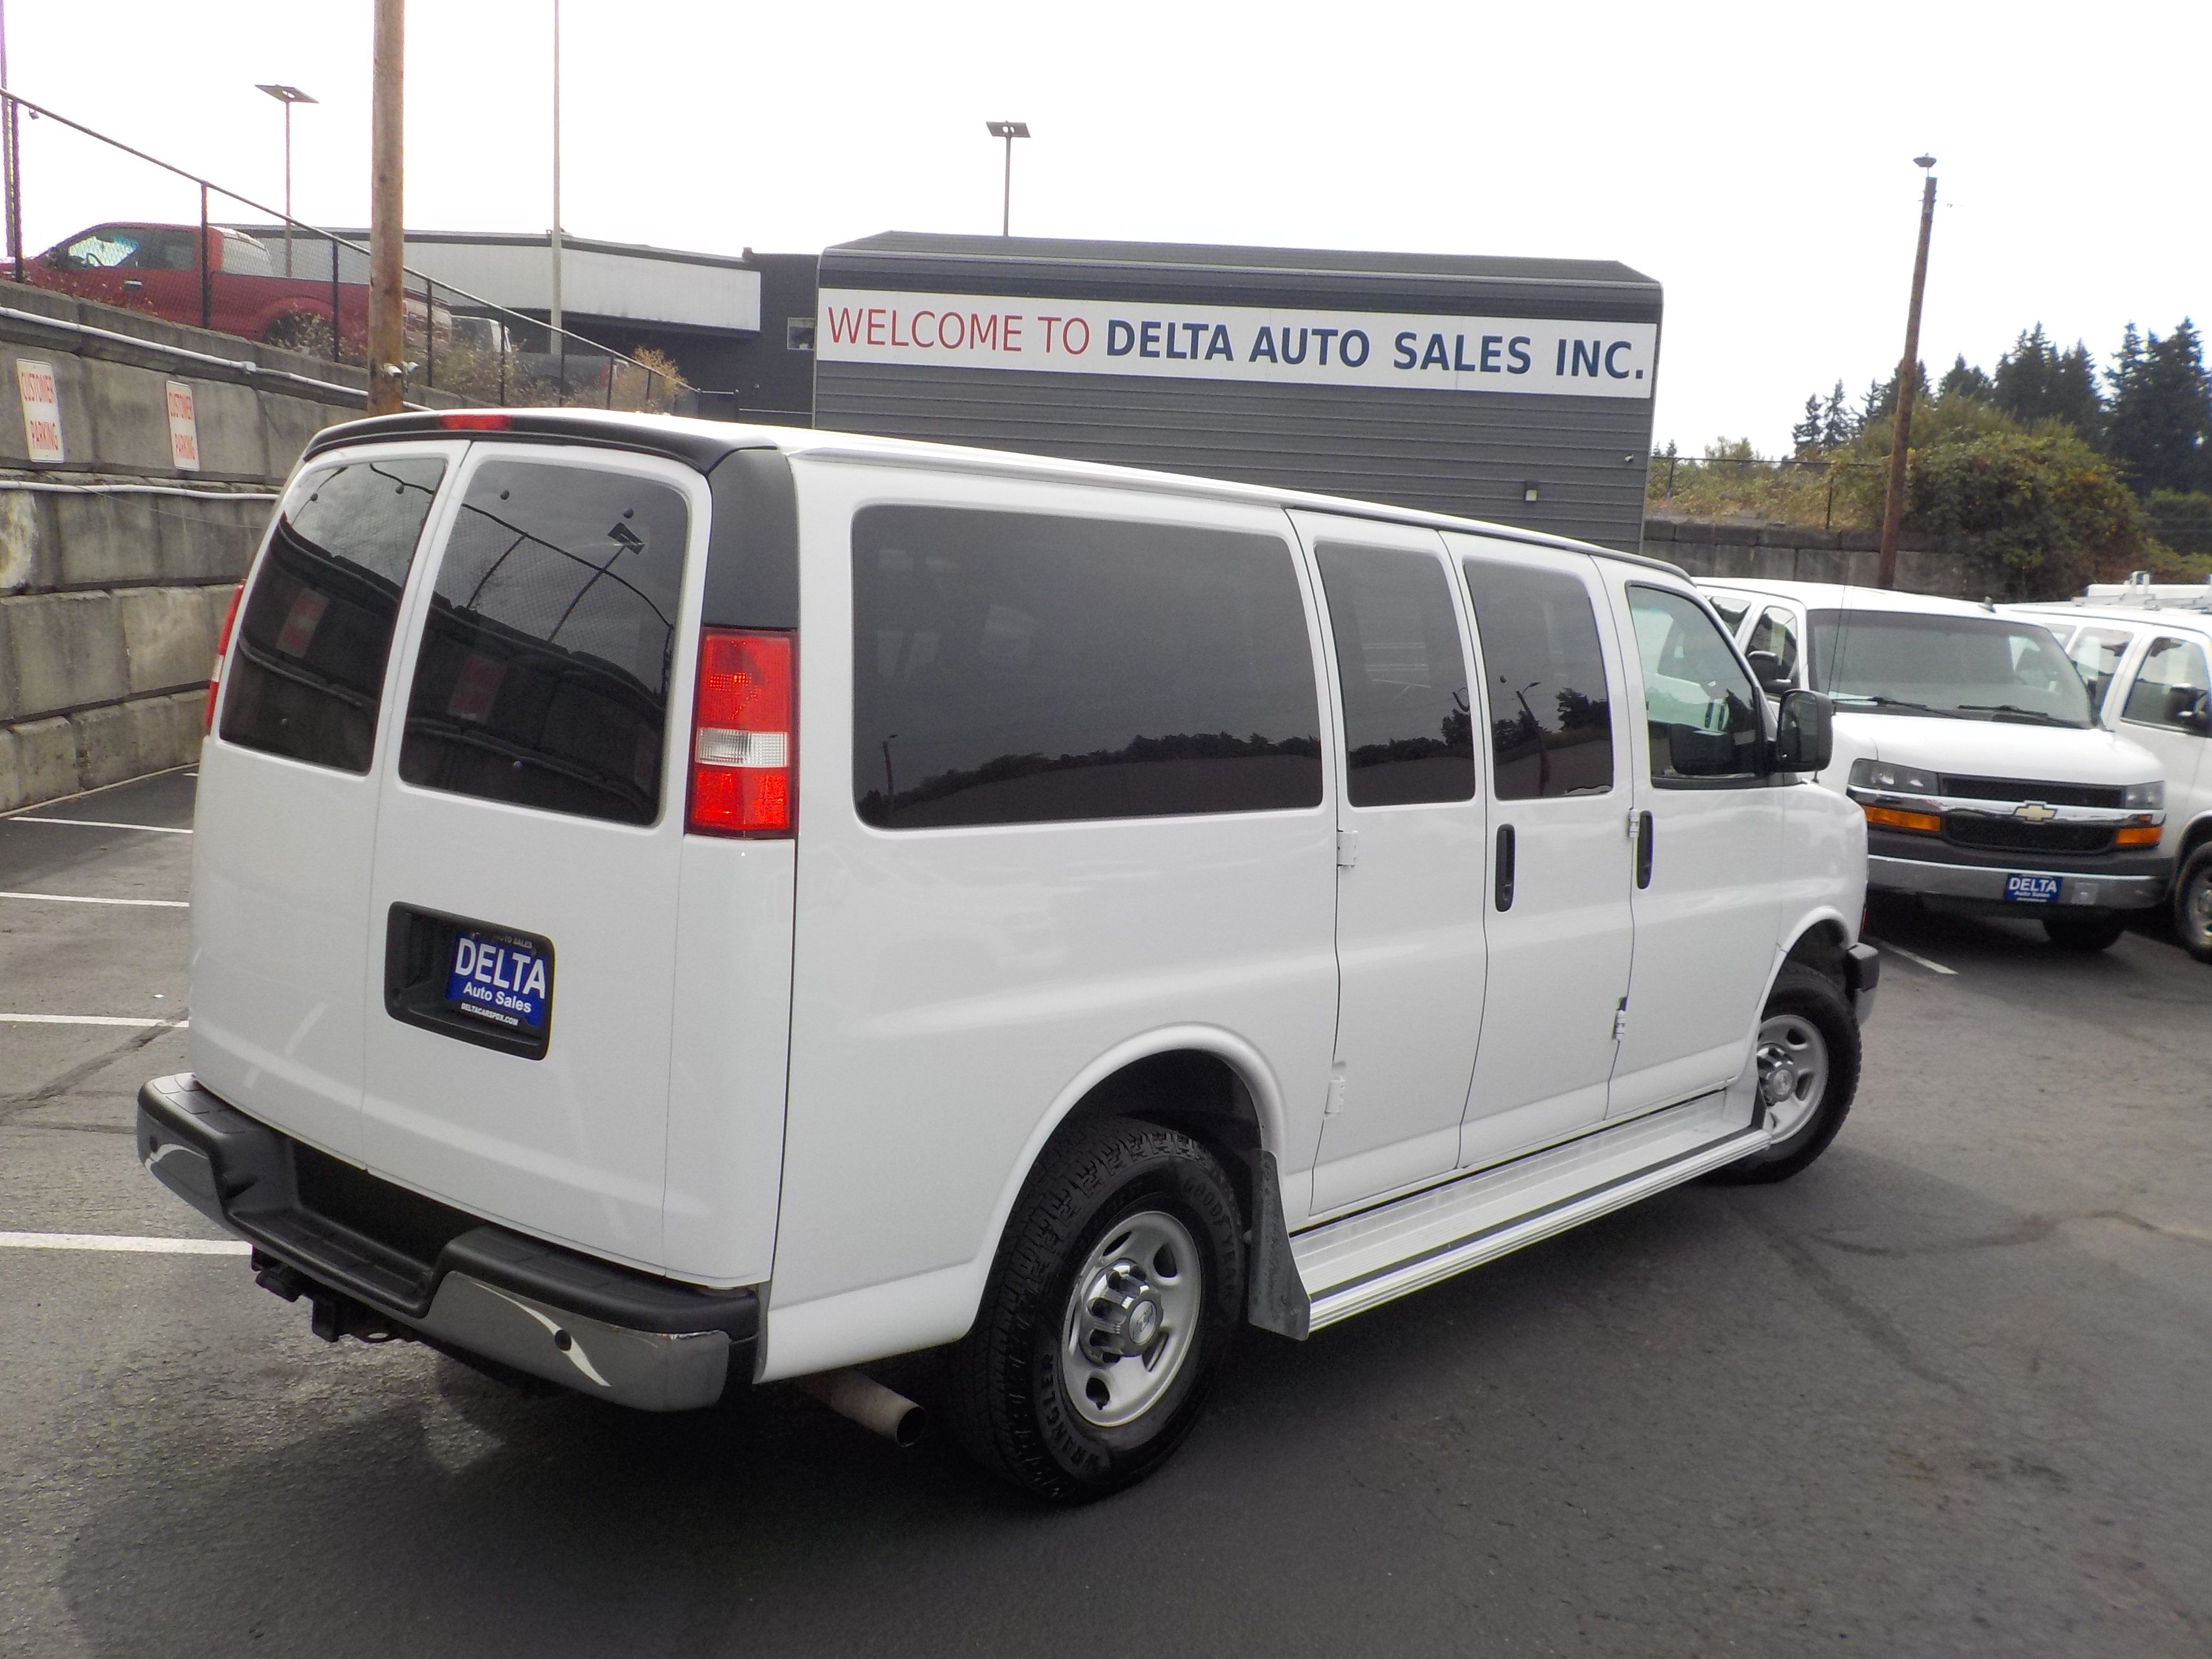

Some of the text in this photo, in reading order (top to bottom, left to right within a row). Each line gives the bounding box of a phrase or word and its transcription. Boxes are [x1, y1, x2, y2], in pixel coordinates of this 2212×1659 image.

[828, 307, 1644, 379] WELCOME TO DELTA AUTO SALES INC.
[21, 372, 55, 404] CUSTOMER
[169, 392, 192, 420] CUSTOMER
[30, 420, 58, 451] PARKING
[174, 433, 196, 460] PARKING
[2009, 877, 2057, 893] DELTA
[513, 937, 533, 949] SALES
[455, 937, 546, 999] DELTA
[463, 982, 532, 1013] Auto Sales
[461, 1002, 518, 1026] DELTACARSPDX.COM
[1184, 1176, 1236, 1298] GOODYEAR
